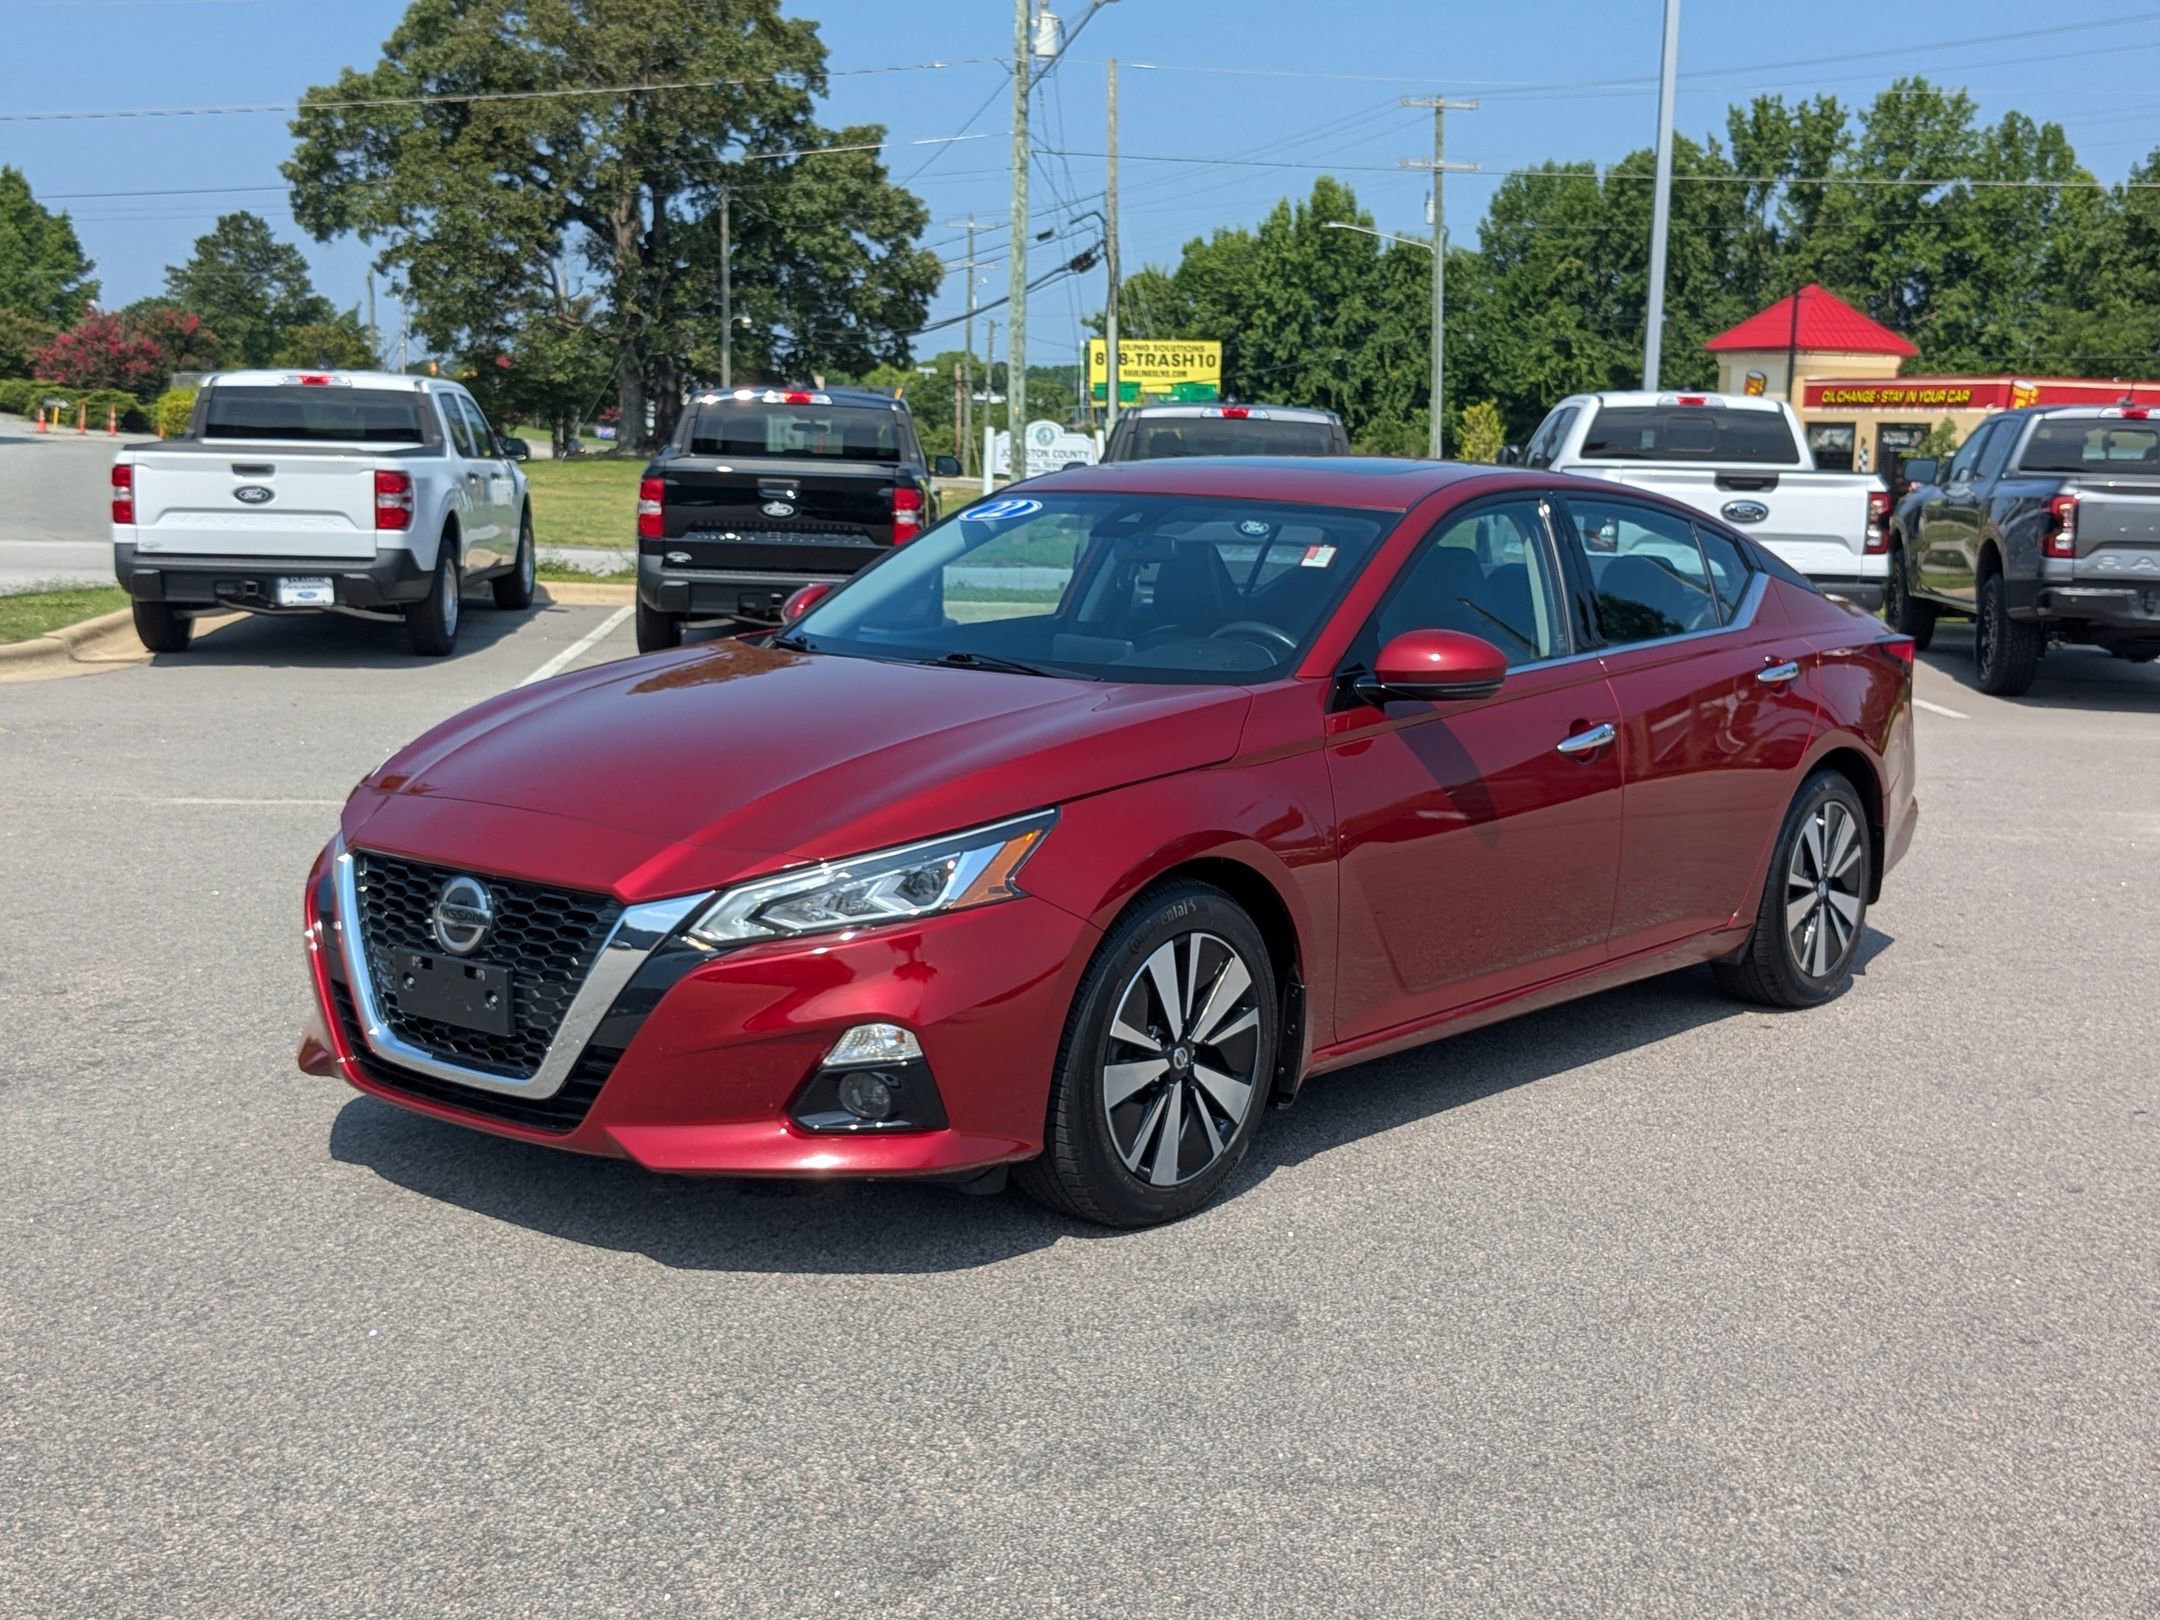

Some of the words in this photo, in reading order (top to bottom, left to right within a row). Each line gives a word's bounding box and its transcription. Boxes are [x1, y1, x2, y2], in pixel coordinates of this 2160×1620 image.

[1095, 352, 1217, 368] 88-TRASH10
[1821, 390, 1836, 402] OIL
[1837, 390, 1876, 403] CHANGE
[1879, 390, 1904, 403] STAY
[1905, 390, 1917, 402] IN
[1918, 390, 1946, 403] YOUR
[1946, 390, 1971, 403] CAR
[1053, 449, 1089, 459] COUNTY
